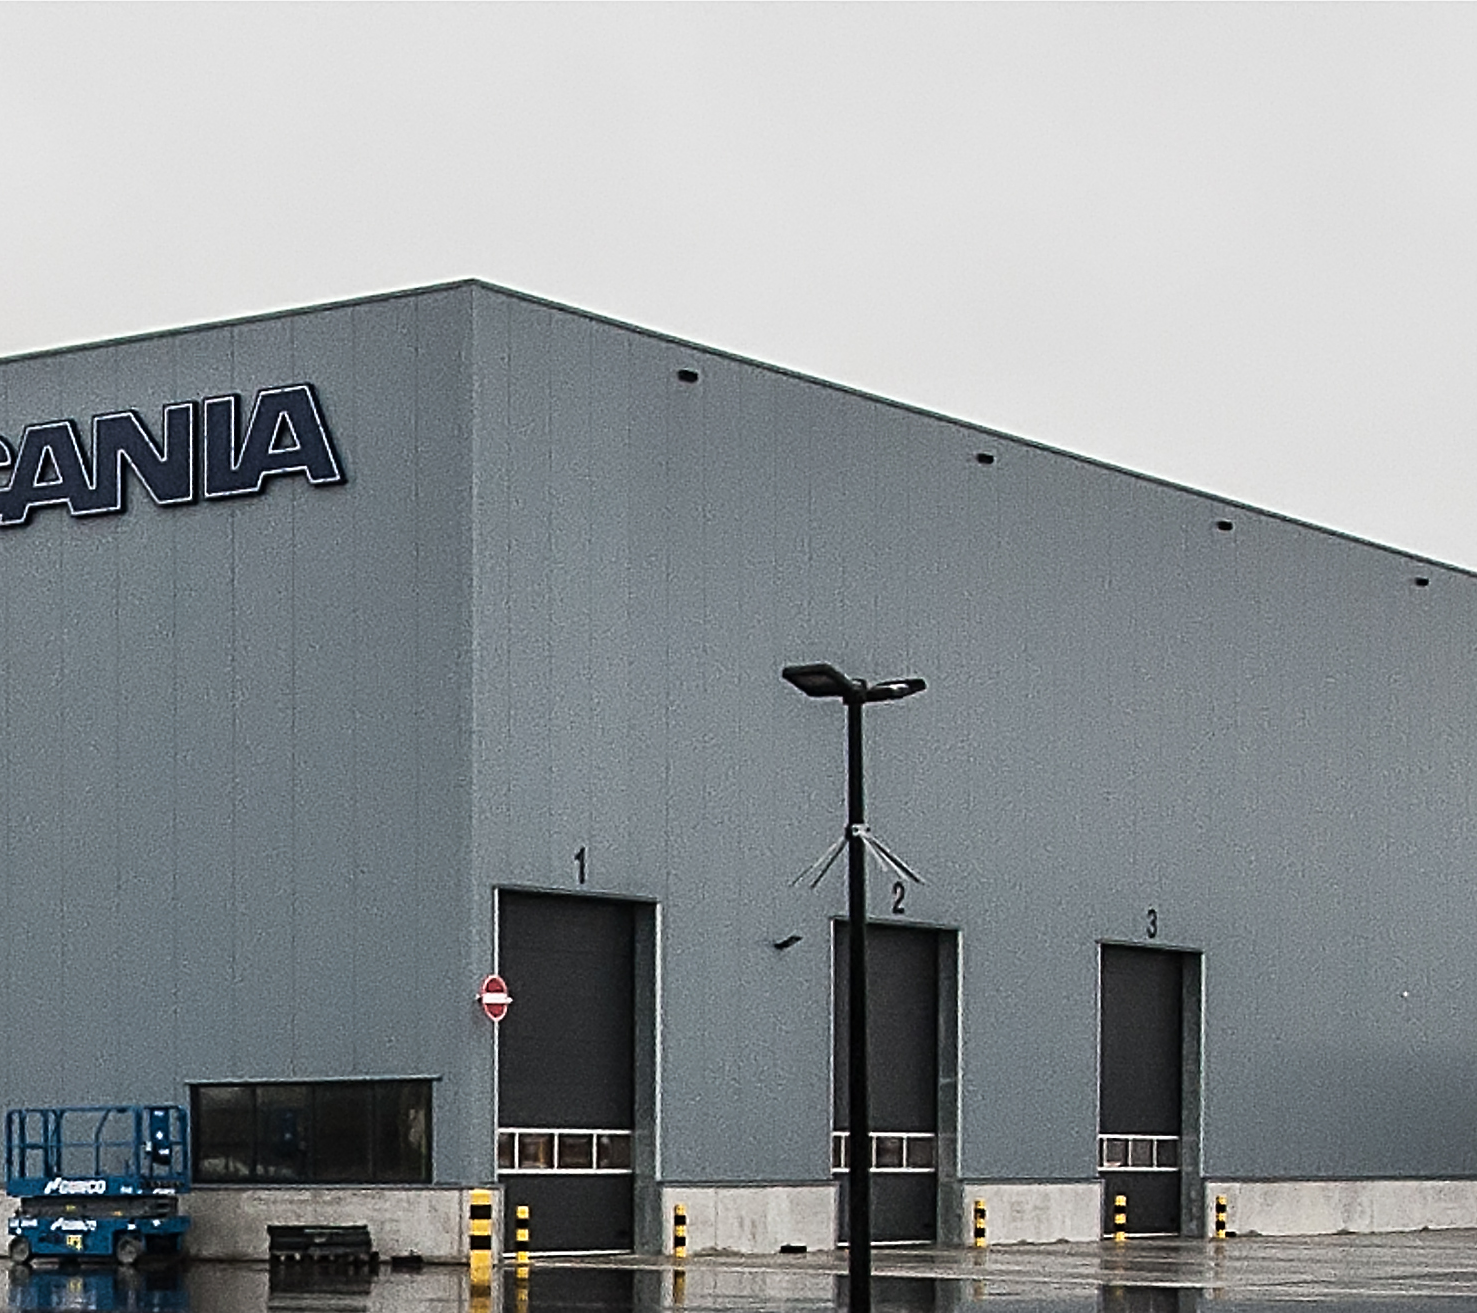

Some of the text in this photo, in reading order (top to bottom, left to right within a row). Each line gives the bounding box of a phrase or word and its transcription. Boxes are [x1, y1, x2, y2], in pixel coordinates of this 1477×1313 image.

[574, 845, 586, 884] 1
[892, 880, 905, 914] 2
[1146, 908, 1158, 938] 3
